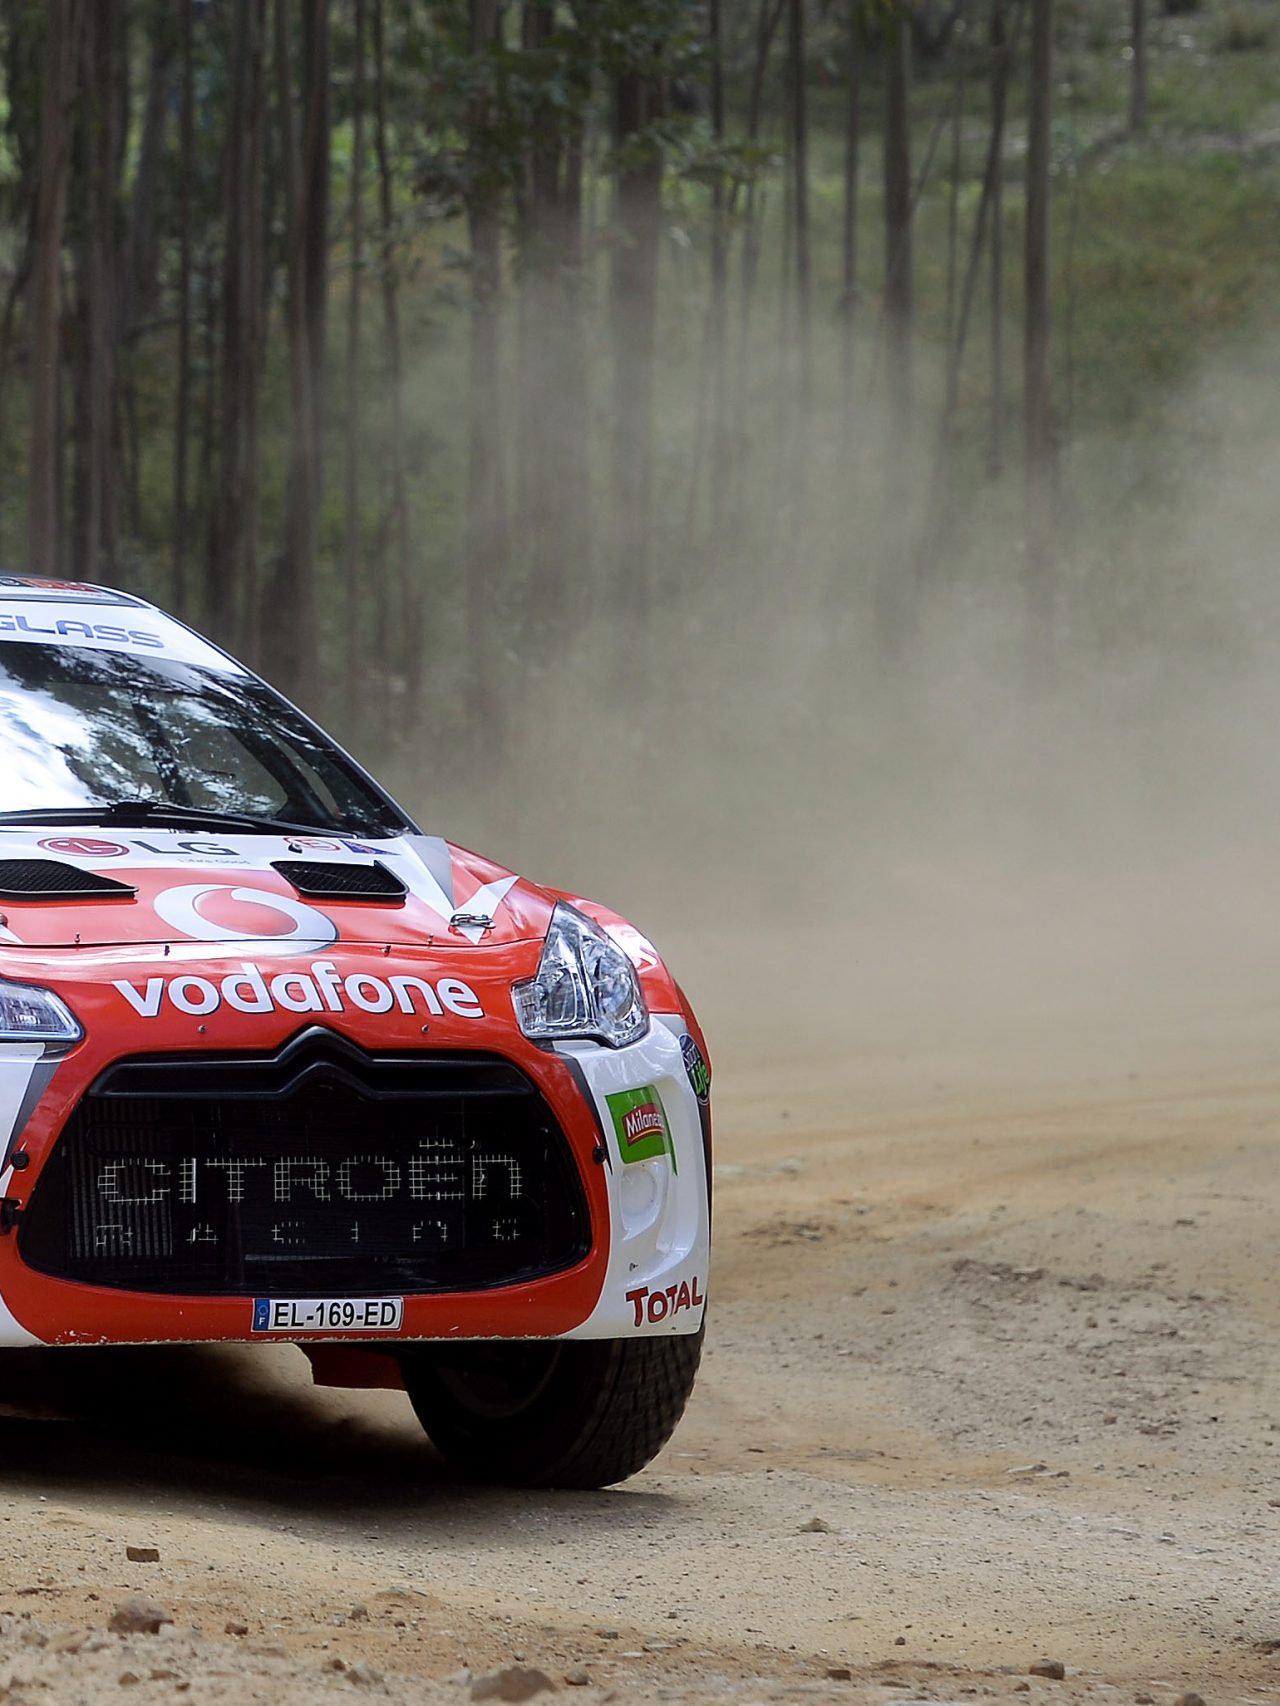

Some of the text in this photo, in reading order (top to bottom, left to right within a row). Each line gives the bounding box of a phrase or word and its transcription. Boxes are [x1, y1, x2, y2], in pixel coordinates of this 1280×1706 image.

[130, 840, 239, 855] LG
[111, 962, 485, 1018] vodafone
[626, 1276, 703, 1327] TOTAL
[258, 1317, 266, 1326] F
[274, 1302, 397, 1327] EL-169-ED
